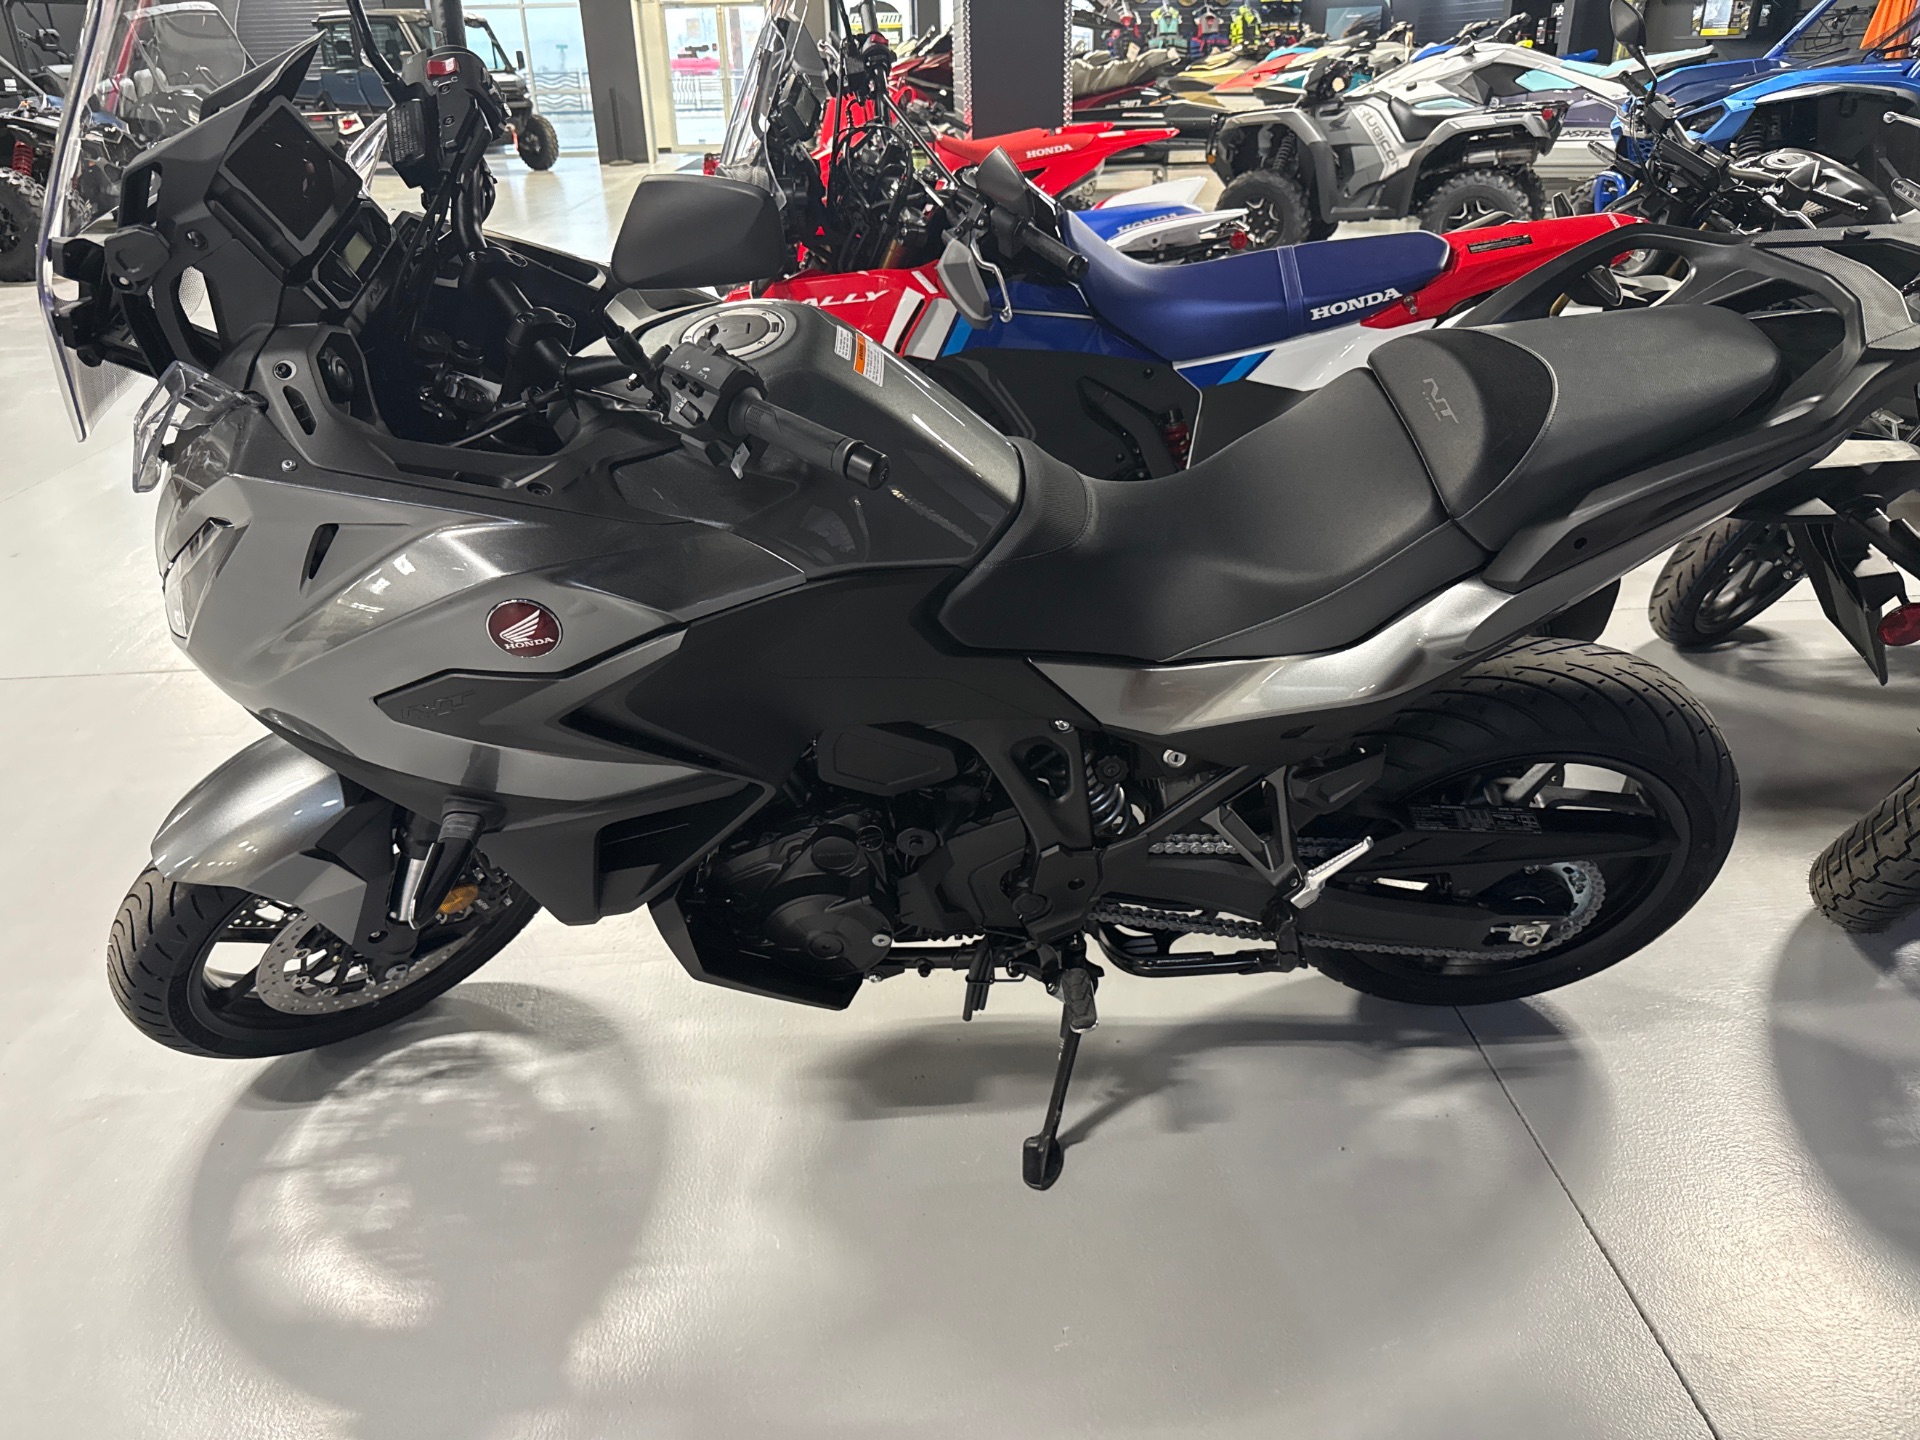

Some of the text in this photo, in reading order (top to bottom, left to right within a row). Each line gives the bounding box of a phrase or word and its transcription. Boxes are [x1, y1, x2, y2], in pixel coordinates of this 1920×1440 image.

[1560, 129, 1611, 139] ASTER
[1025, 143, 1074, 159] HONDA
[801, 289, 890, 307] ALLY
[1309, 287, 1403, 321] HONDA
[503, 637, 556, 650] HONDA
